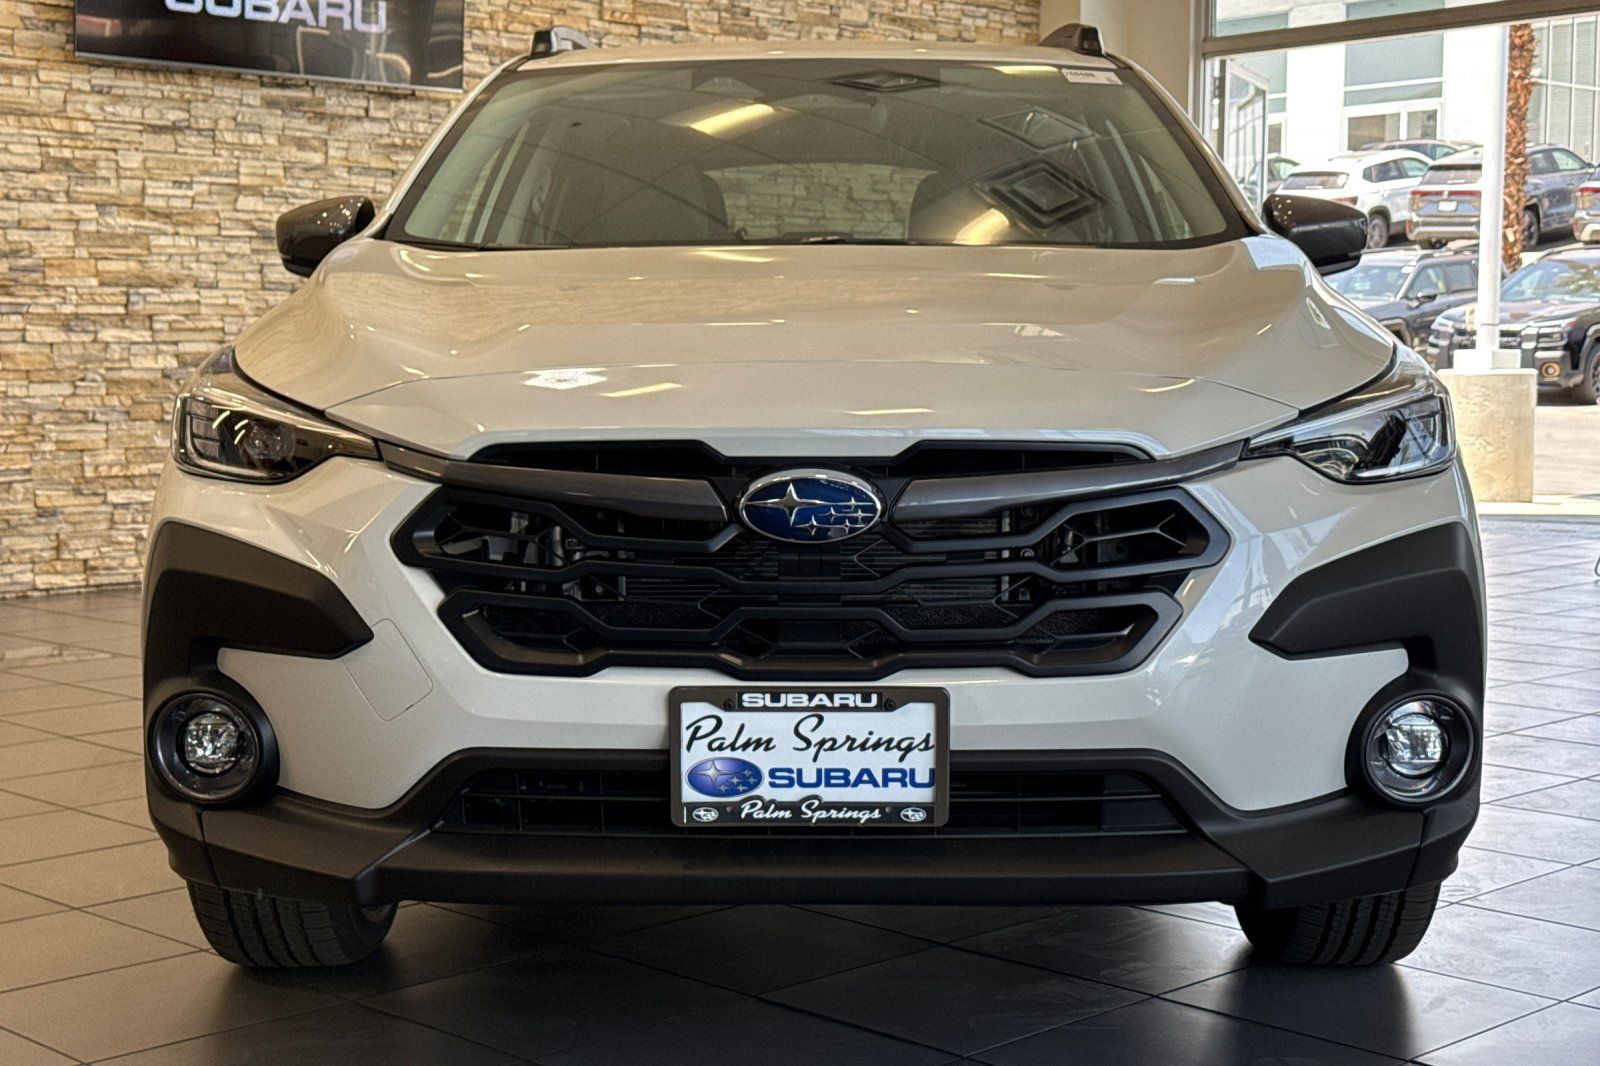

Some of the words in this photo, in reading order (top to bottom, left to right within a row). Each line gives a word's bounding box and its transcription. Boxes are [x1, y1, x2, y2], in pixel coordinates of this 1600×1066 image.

[741, 692, 878, 708] SUBARU
[685, 714, 777, 753] Palm
[792, 713, 936, 763] Springs
[768, 767, 936, 789] SUBARU
[740, 799, 792, 820] Palm
[800, 799, 882, 824] Springs
